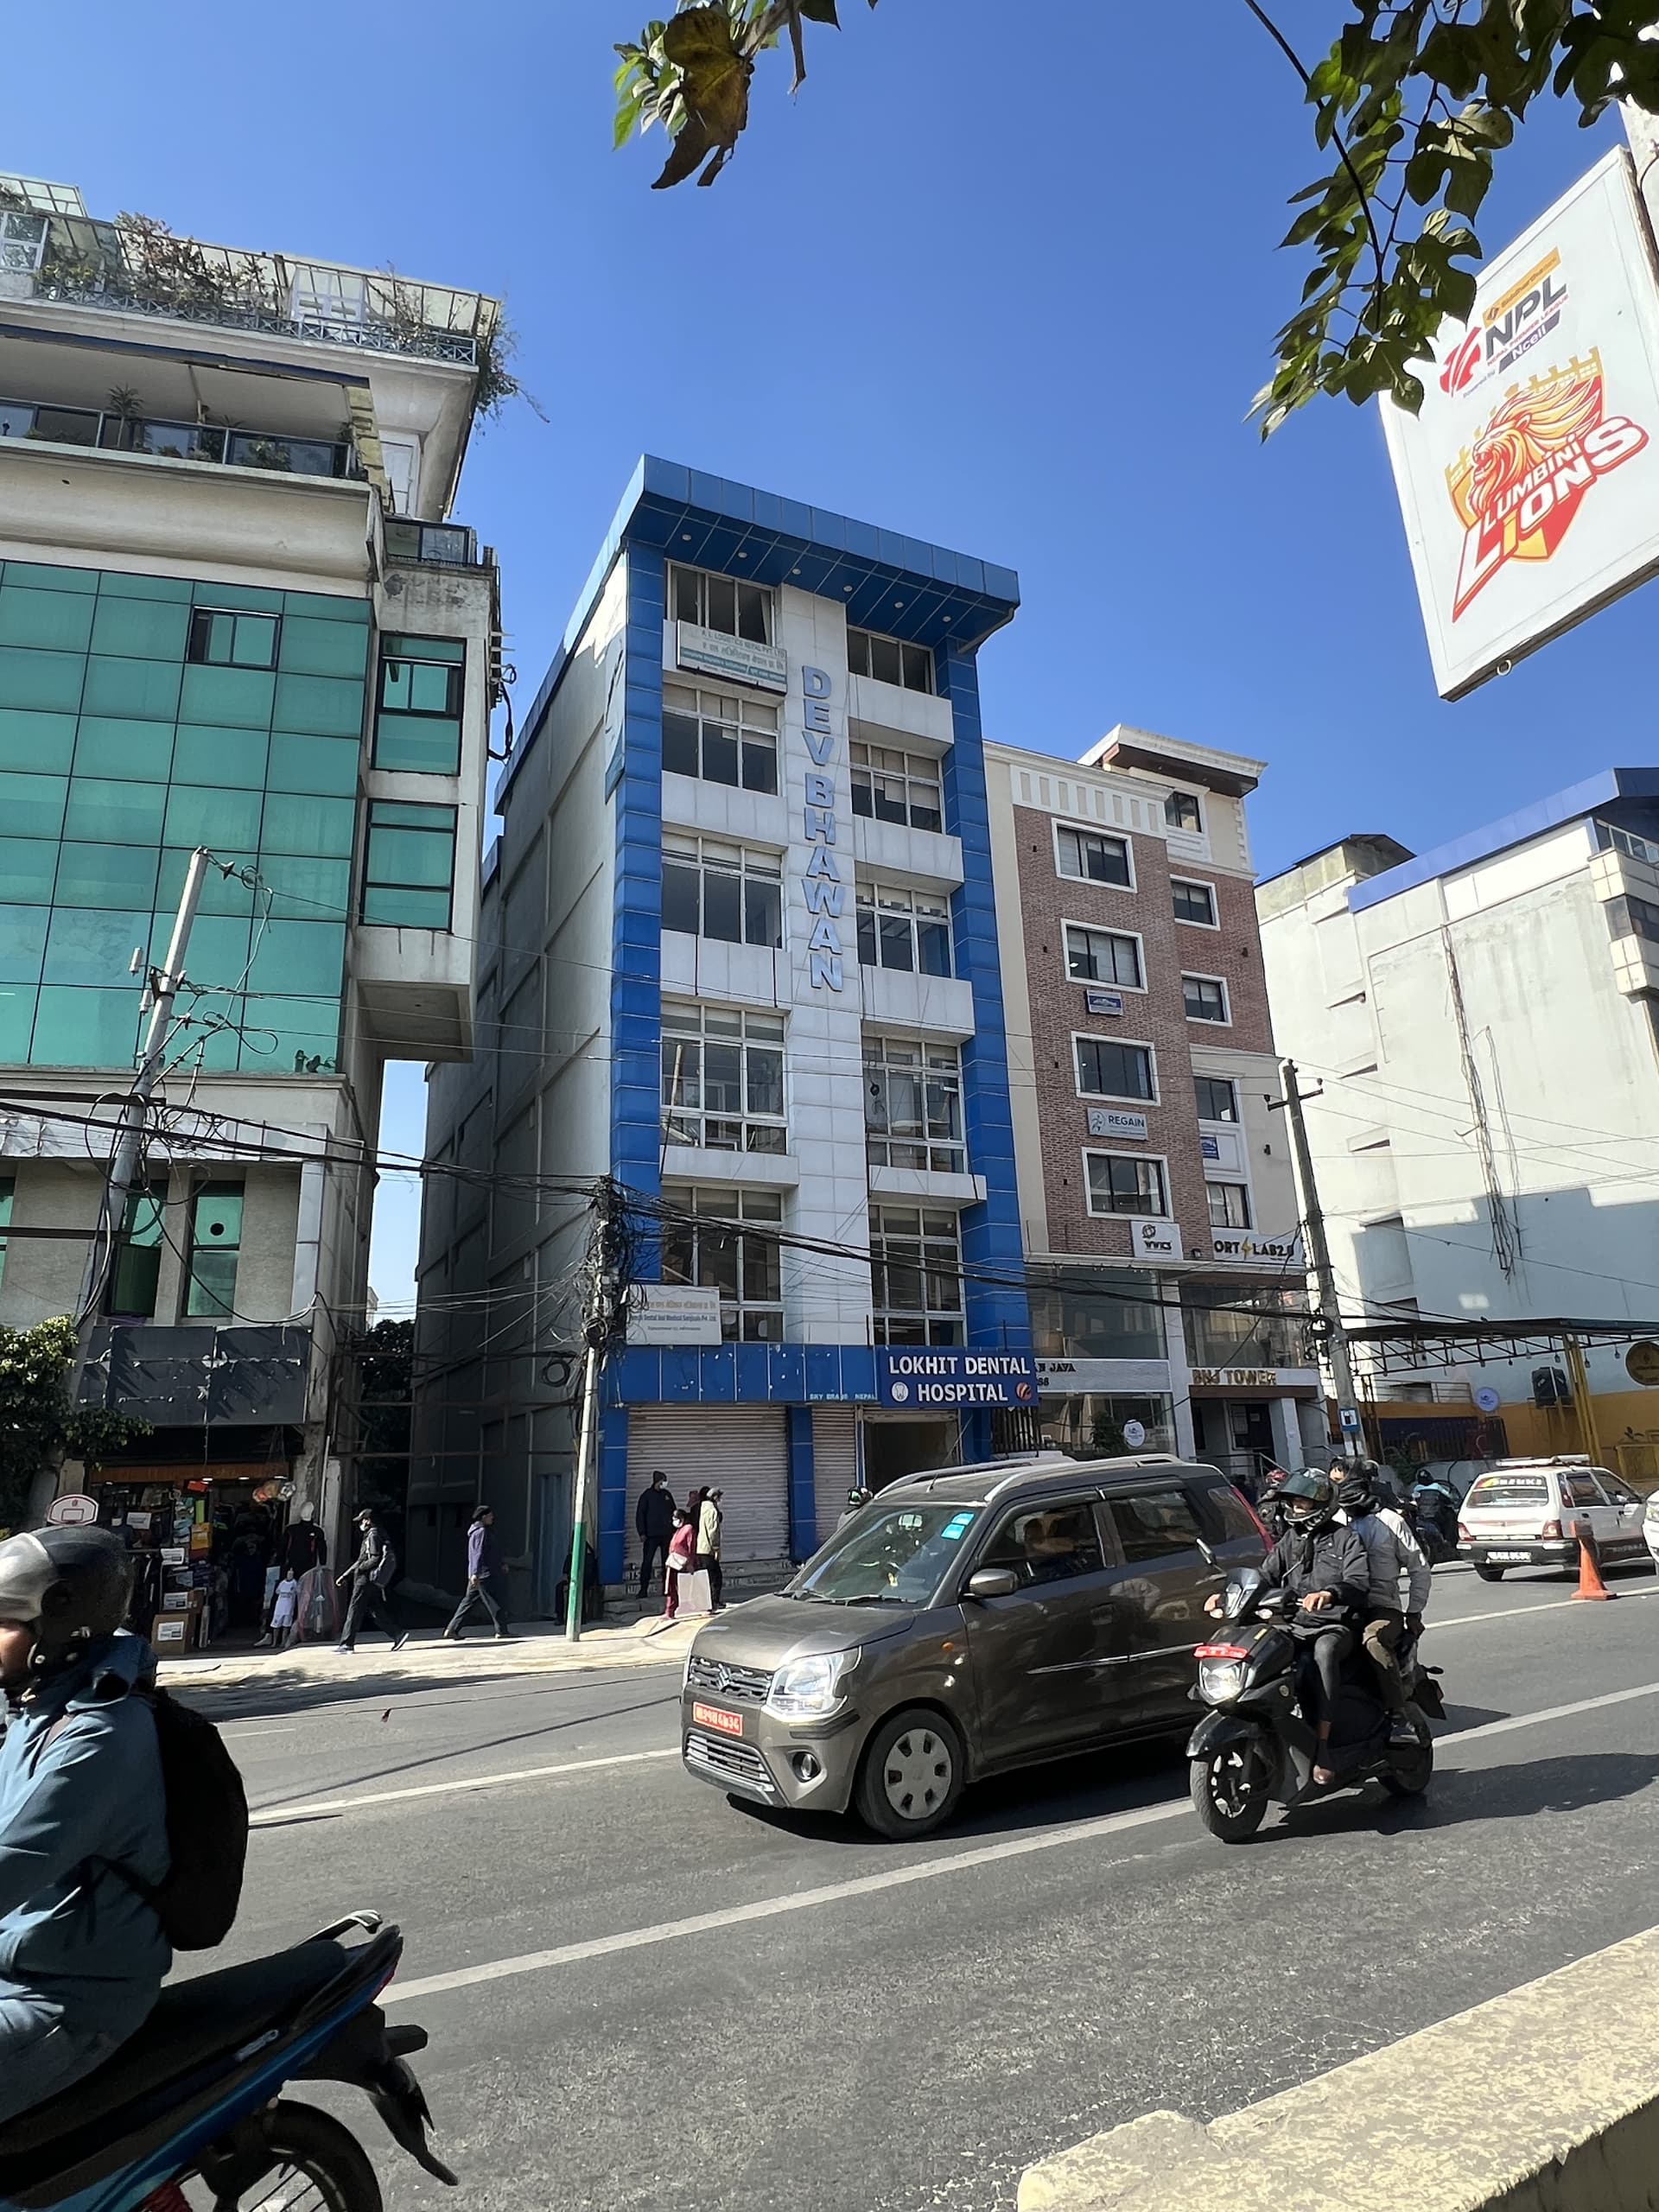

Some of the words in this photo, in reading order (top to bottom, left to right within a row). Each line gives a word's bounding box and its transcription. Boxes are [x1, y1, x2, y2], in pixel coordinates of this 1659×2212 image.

[1485, 275, 1567, 361] NPL
[1541, 294, 1569, 321] LEAGUE
[1513, 324, 1547, 360] Ncell
[802, 664, 834, 766] DEV
[801, 772, 845, 993] BHAWAN
[1108, 1115, 1145, 1128] REGAIN
[889, 1356, 957, 1375] LOKHIT
[965, 1357, 1030, 1375] DENTAL
[1049, 1363, 1076, 1372] JAVA
[1224, 1369, 1277, 1385] TOWER
[918, 1383, 1008, 1402] HOSPITAL
